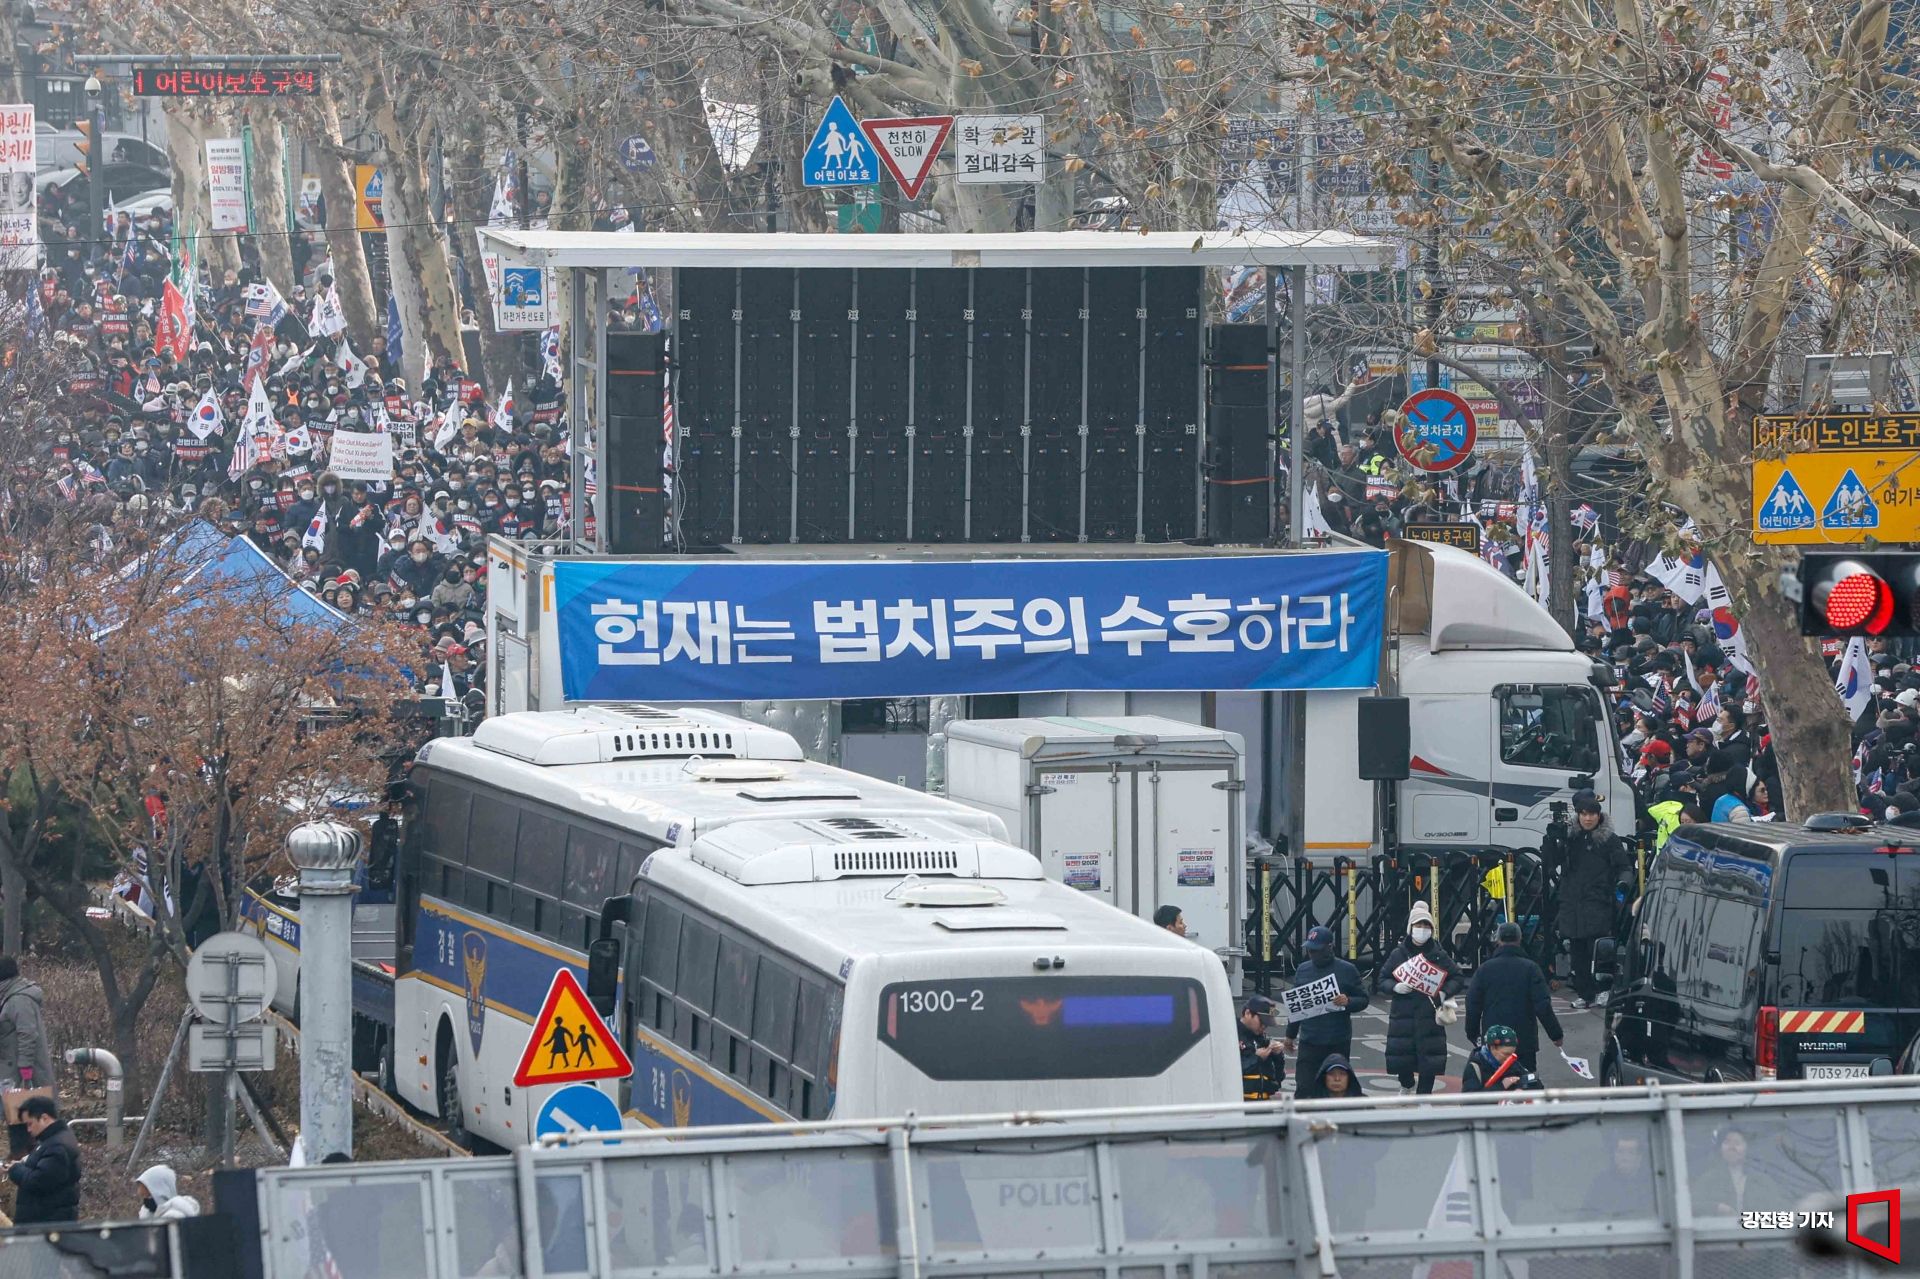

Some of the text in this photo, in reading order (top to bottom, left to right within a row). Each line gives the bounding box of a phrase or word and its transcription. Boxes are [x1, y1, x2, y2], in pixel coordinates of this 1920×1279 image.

[156, 71, 313, 93] 어린이보호구역
[887, 130, 926, 145] 천천히
[894, 147, 923, 158] SLOW
[964, 154, 1036, 173] 절대감속
[814, 170, 871, 182] 어린이보호
[503, 311, 545, 322] 자전거우선도로
[1762, 515, 1812, 527] 어린이보호
[591, 592, 1356, 666] 헌재는 법치주의 수호하라
[1410, 955, 1439, 977] STOP
[1285, 977, 1337, 1001] 부정선거
[1396, 969, 1434, 995] STEAL
[899, 990, 985, 1013] 1300-2
[1799, 1042, 1847, 1050] HYUNDAI
